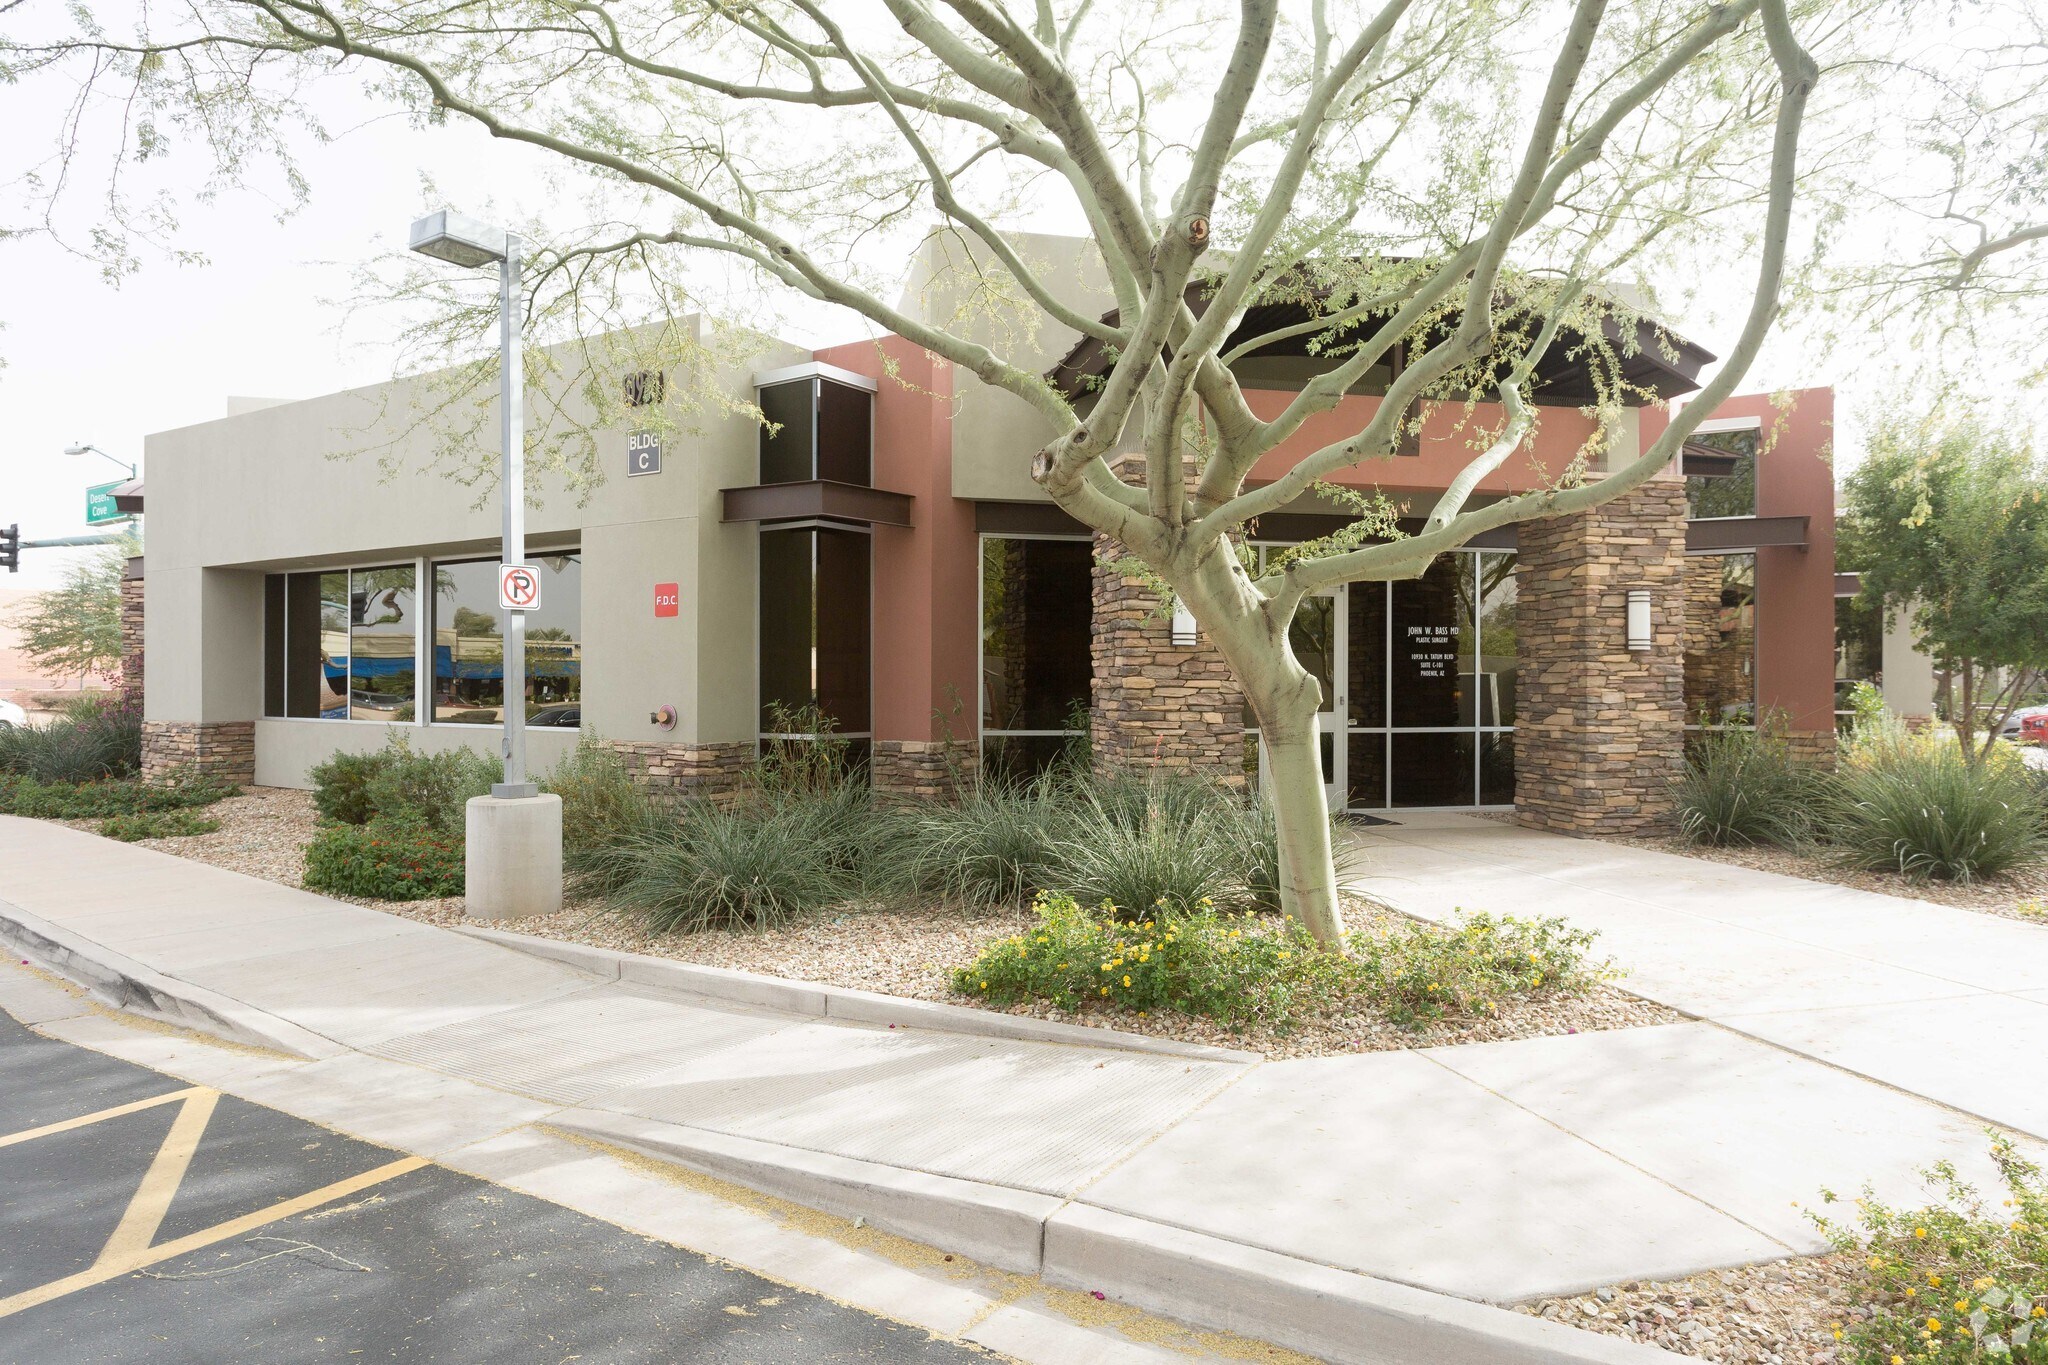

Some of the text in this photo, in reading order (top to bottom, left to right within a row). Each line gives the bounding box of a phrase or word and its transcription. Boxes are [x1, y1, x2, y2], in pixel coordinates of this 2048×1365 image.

[629, 433, 659, 451] BLDG
[638, 452, 649, 469] C
[92, 506, 107, 516] Cove
[1408, 626, 1459, 637] JOHN W. BASS MD
